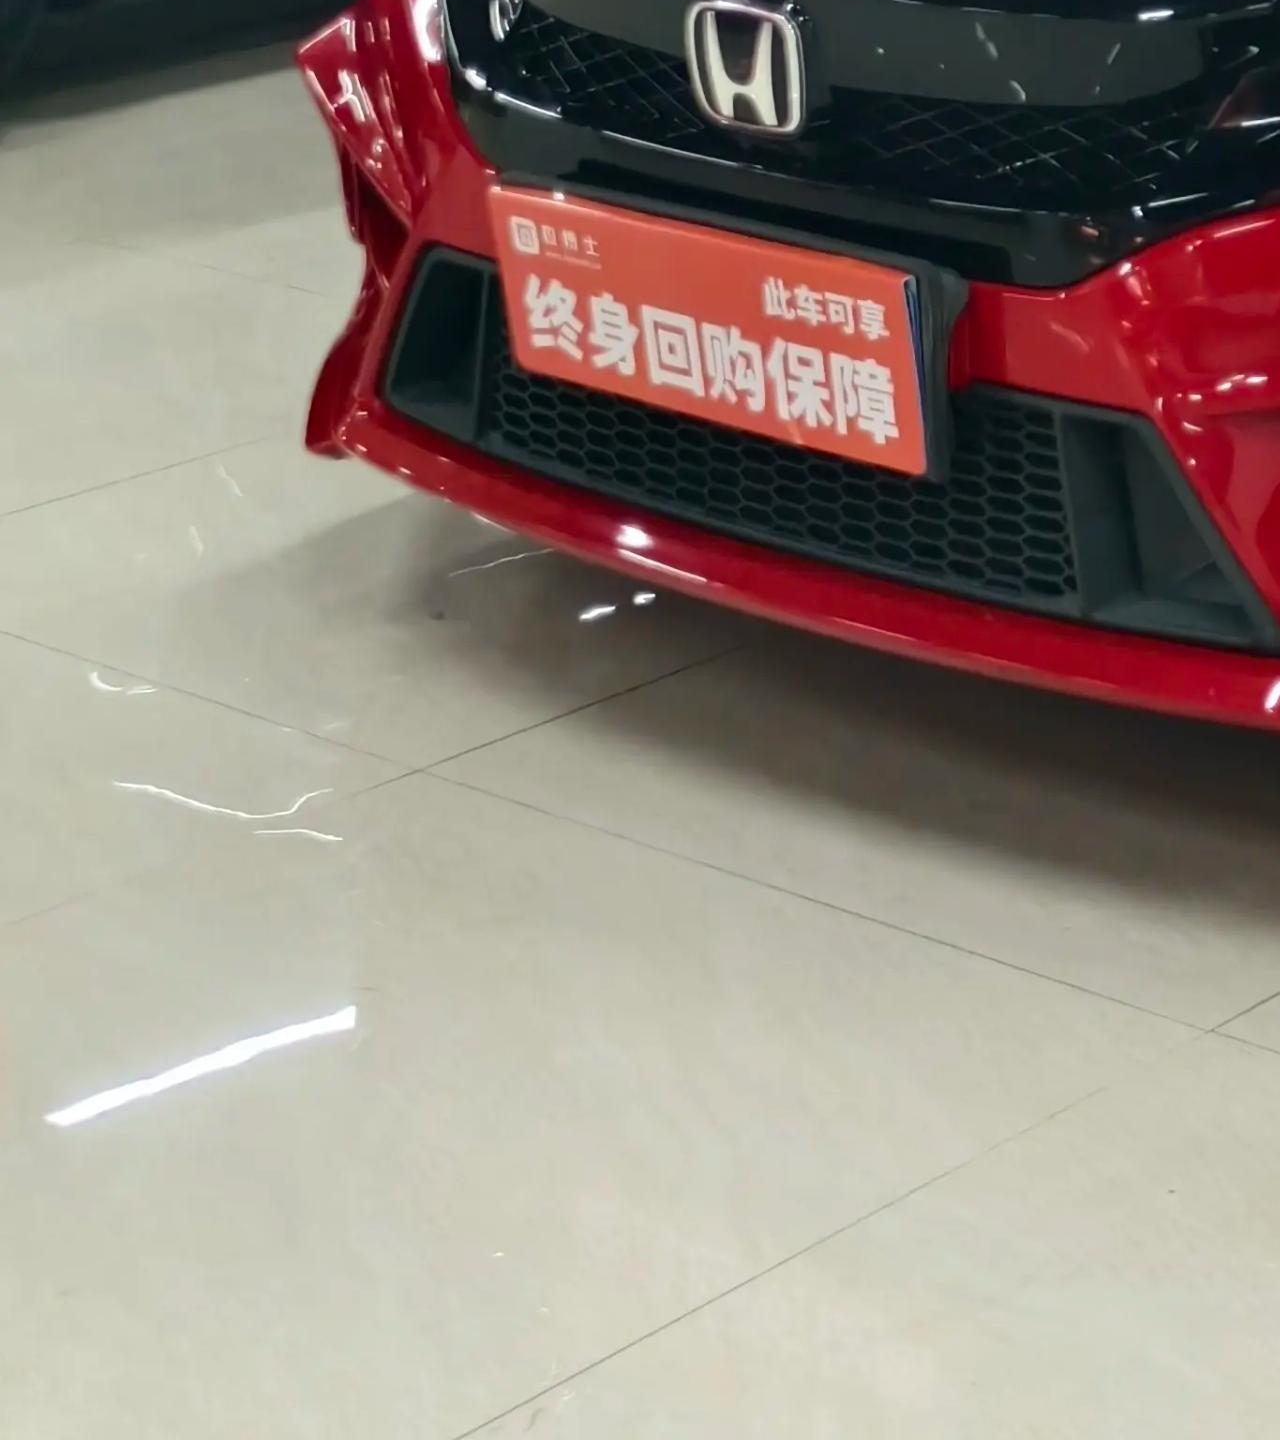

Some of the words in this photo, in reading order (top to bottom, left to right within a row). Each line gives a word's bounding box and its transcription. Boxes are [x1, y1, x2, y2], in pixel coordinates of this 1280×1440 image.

[523, 273, 900, 445] 终身回购保障
[762, 276, 891, 340] 此车可享
